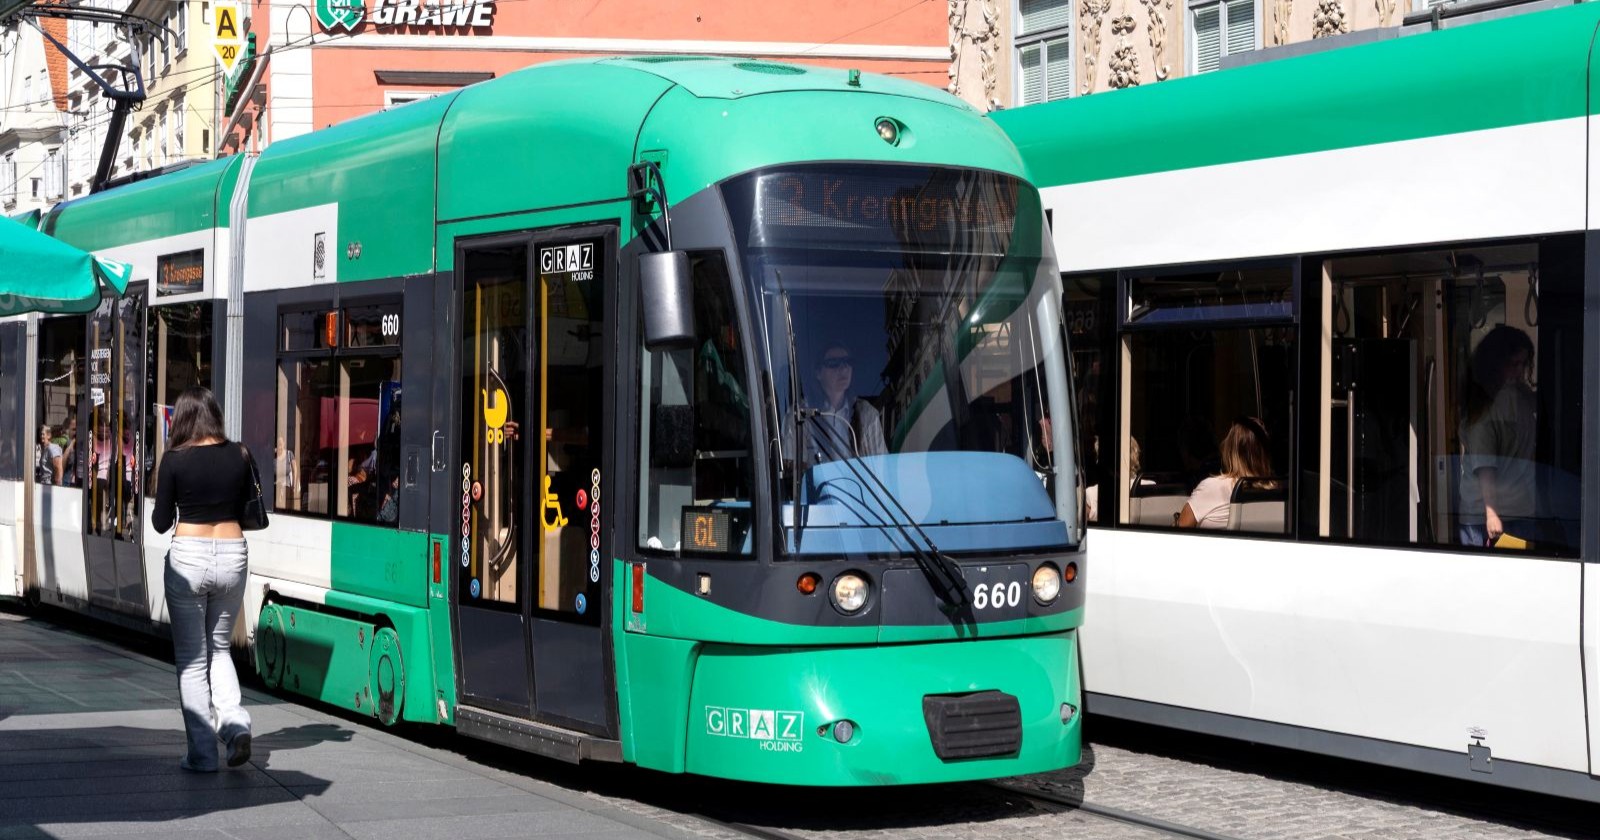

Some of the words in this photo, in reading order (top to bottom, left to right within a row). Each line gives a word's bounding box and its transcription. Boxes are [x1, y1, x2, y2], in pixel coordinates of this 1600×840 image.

[217, 9, 237, 37] A
[372, 0, 493, 27] GRAWE
[222, 45, 236, 60] 20
[779, 177, 805, 226] 3
[542, 245, 592, 272] GRAZ
[163, 262, 169, 289] 3
[571, 270, 593, 281] HOLDING
[381, 313, 399, 336] 660
[694, 515, 717, 548] GL
[973, 581, 1021, 610] 660
[706, 707, 803, 740] GRAZ
[759, 740, 803, 753] HOLDING
